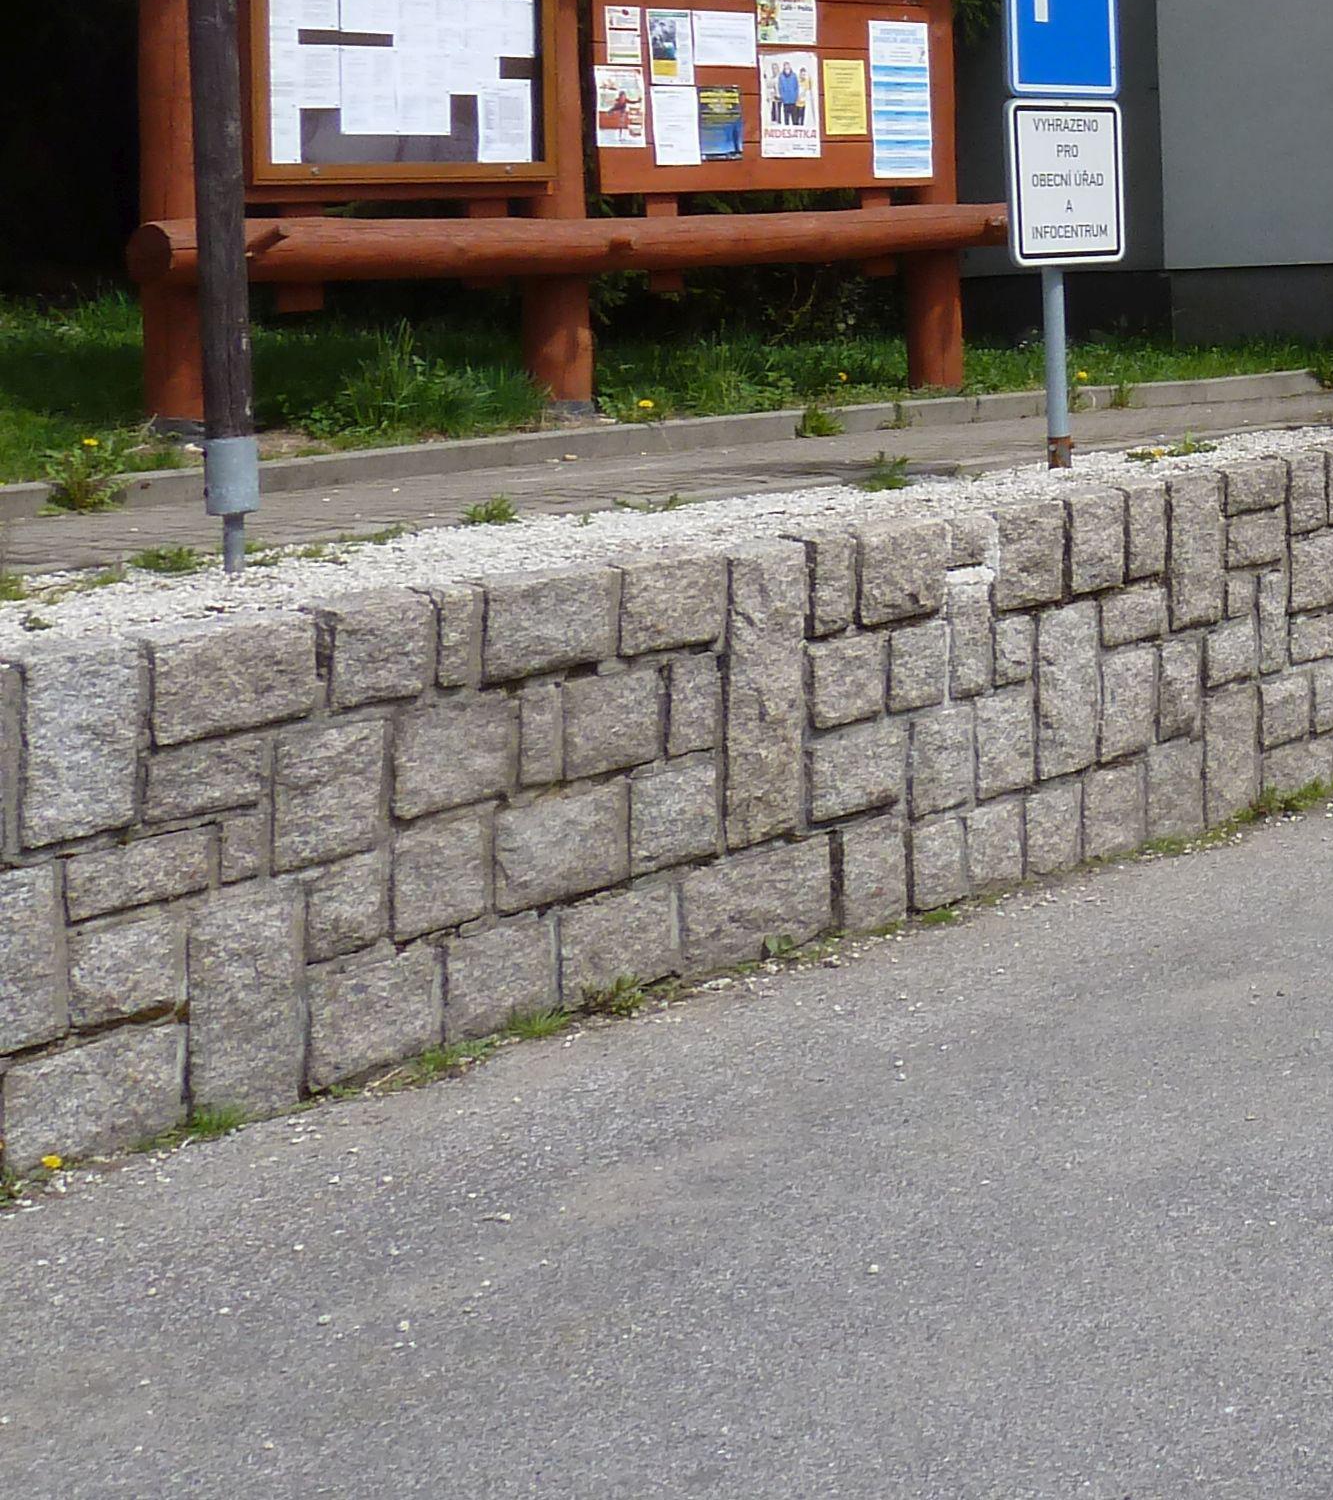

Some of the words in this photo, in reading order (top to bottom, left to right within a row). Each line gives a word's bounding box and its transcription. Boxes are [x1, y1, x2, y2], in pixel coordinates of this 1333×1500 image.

[1032, 118, 1099, 133] VYHRAZENO
[1056, 144, 1079, 158] PRO
[1032, 170, 1072, 187] OBECNÍ
[1074, 170, 1104, 187] ÚŘAD
[1065, 199, 1073, 213] A
[1032, 224, 1108, 239] INFOCENTRUM
